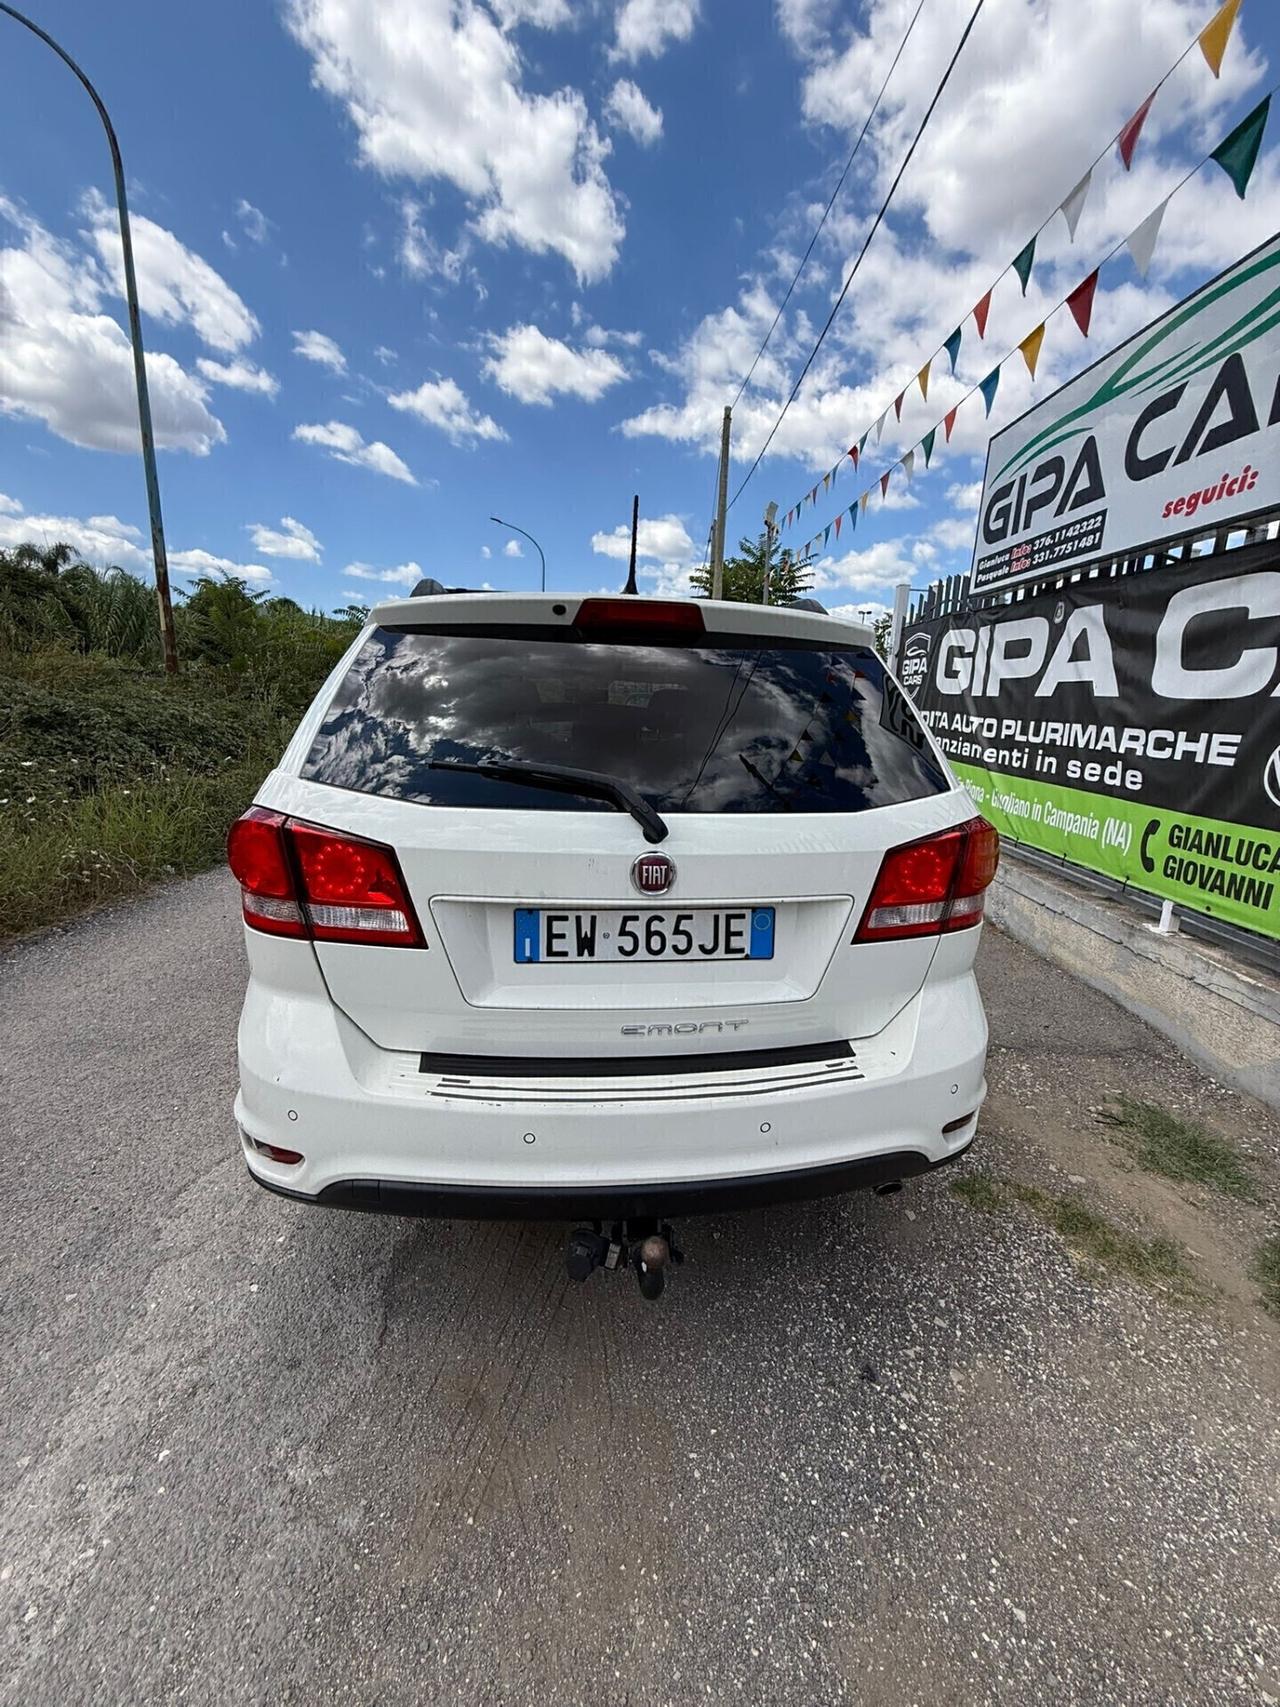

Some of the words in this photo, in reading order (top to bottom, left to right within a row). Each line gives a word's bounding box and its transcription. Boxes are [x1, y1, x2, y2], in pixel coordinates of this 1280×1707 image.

[983, 435, 1106, 544] GIPA
[1125, 353, 1280, 481] CA
[1162, 465, 1259, 518] seguici:
[977, 565, 1009, 583] Pasquale
[1032, 532, 1101, 564] 331.7751481
[979, 553, 1010, 570] Gianluca
[1033, 515, 1103, 550] 376.1142322
[936, 604, 1119, 698] GIPA
[1151, 571, 1280, 699] C
[902, 657, 928, 675] GIPA
[903, 674, 923, 685] CARS
[919, 710, 949, 729] DITA
[951, 713, 998, 738] AUTO
[1001, 719, 1243, 767] PLURIMARCHE
[935, 736, 1029, 769] anziamenti
[1036, 748, 1057, 774] in
[1067, 758, 1143, 790] sede
[1032, 798, 1042, 822] in
[1044, 801, 1100, 840] Campania
[1102, 817, 1132, 857] (NA)
[1168, 824, 1280, 874] GIANLUCA
[642, 865, 668, 885] FIAT
[1163, 855, 1275, 911] GIOVANNI
[546, 914, 597, 957] EW
[617, 913, 747, 957] 565JE
